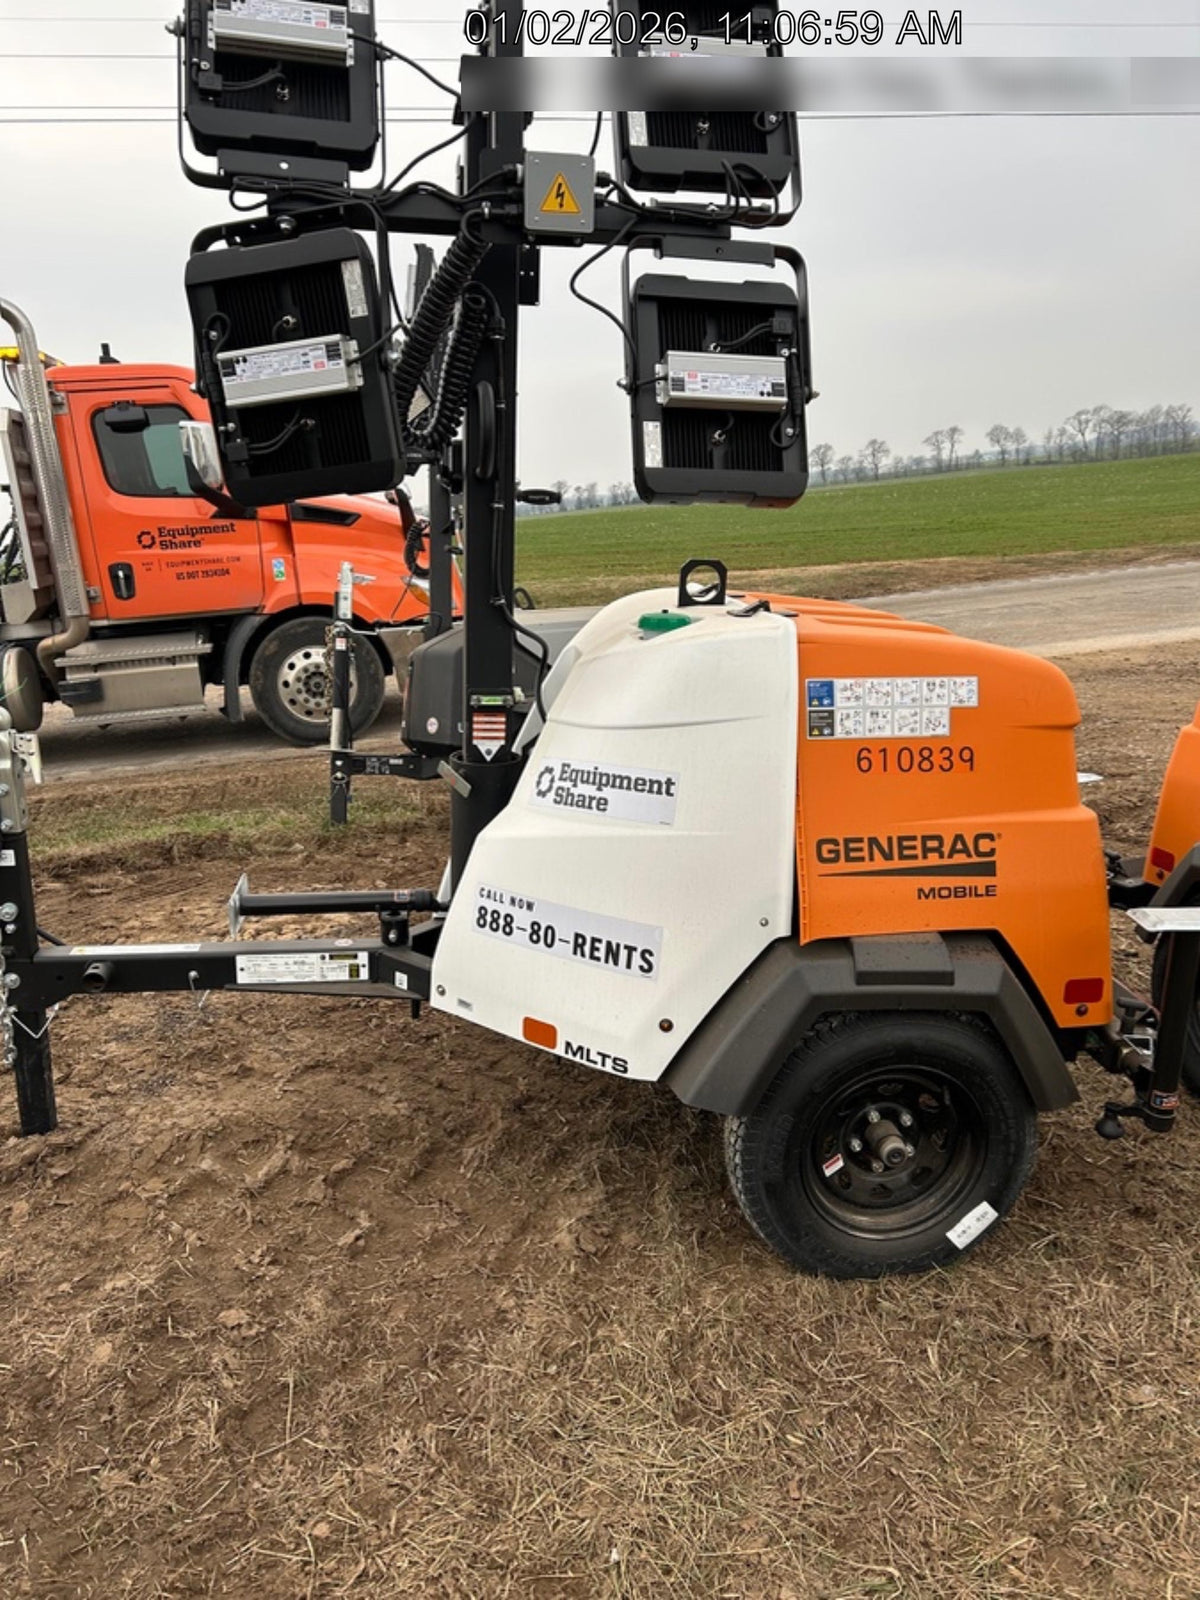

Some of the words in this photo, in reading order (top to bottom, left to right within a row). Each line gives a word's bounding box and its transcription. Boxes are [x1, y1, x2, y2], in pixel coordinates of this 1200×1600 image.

[157, 522, 236, 539] Equipment
[159, 539, 202, 550] Share
[856, 746, 975, 772] 610839
[558, 762, 676, 797] Equipment
[552, 786, 609, 812] Share
[479, 887, 504, 904] CALL
[510, 896, 535, 912] NOW
[917, 885, 997, 900] MOBILE
[476, 905, 655, 974] 888-80-RENTS
[564, 1040, 628, 1074] MLTS
